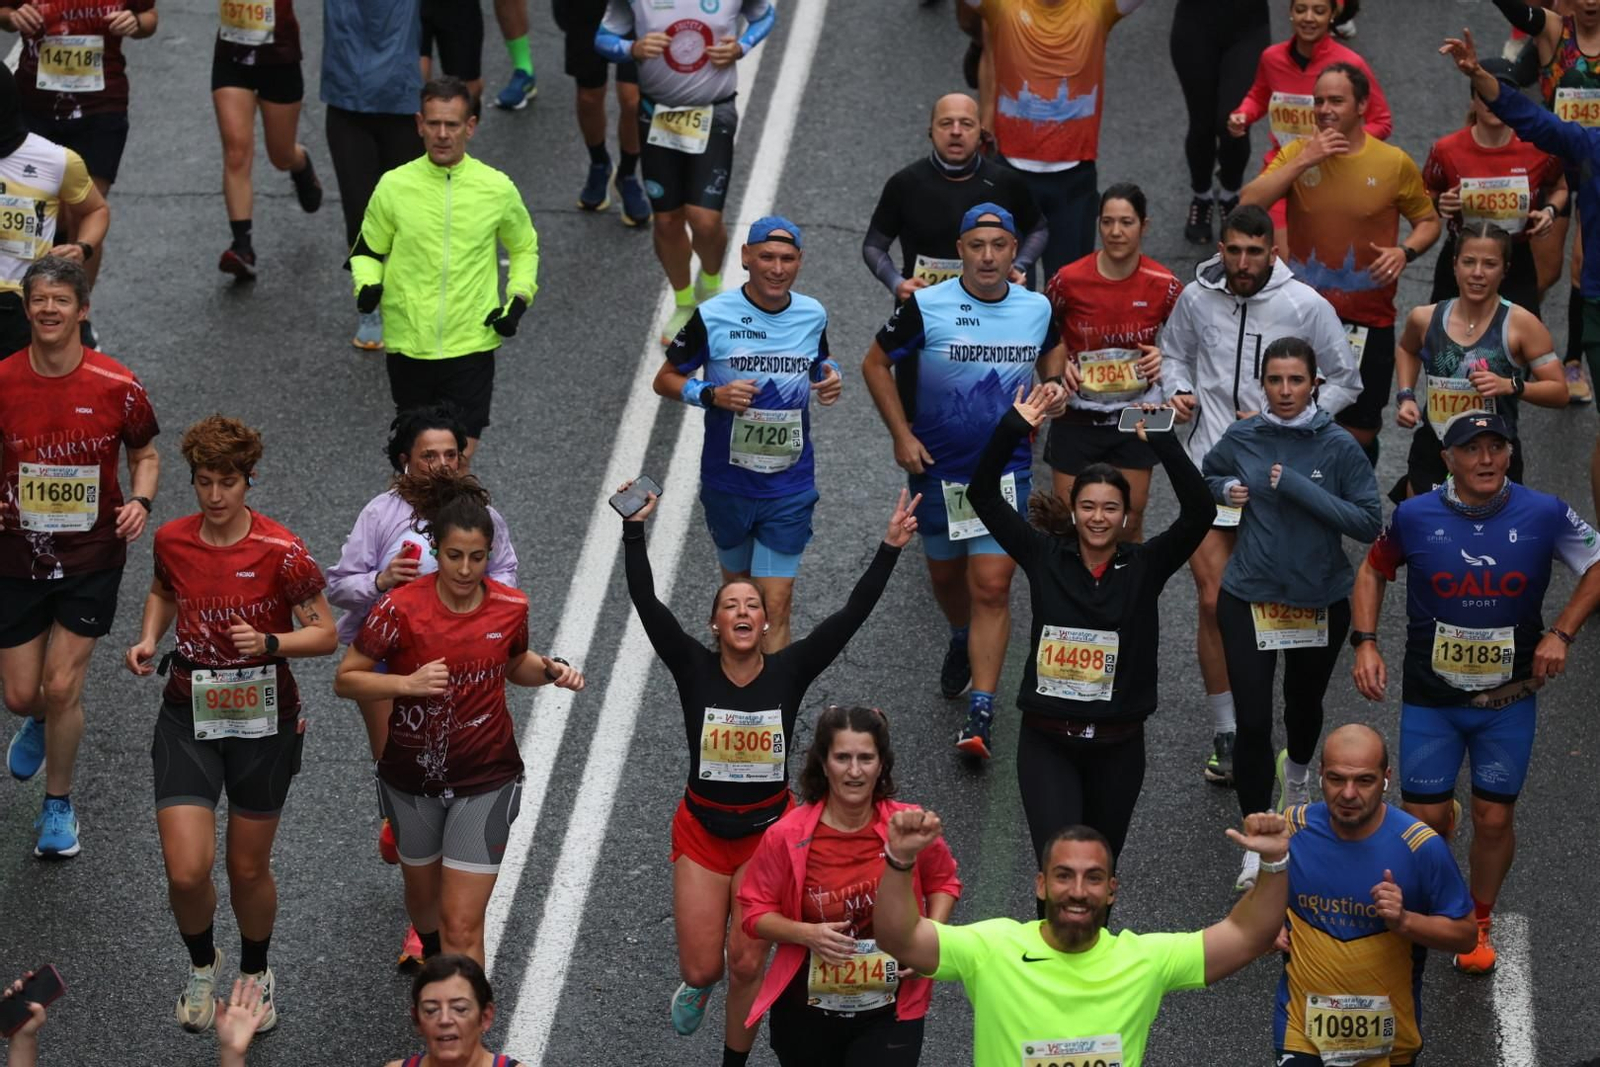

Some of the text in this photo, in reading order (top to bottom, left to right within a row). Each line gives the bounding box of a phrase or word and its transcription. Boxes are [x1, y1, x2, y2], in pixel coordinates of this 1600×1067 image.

[44, 48, 93, 67] 14718
[1466, 192, 1519, 211] 12633
[955, 316, 980, 327] JAVI
[729, 330, 767, 340] ANTONIO
[949, 344, 1037, 363] INDEPENDIENTES
[1086, 362, 1136, 385] 13641
[743, 424, 788, 446] 7120
[26, 481, 85, 502] 11680
[1431, 569, 1528, 599] GALO
[1462, 599, 1498, 608] SPORT
[1044, 644, 1104, 671] 14498
[1440, 641, 1501, 664] 13183
[205, 685, 259, 710] 9266
[709, 728, 771, 752] 11306
[830, 877, 878, 904] MEDI
[818, 958, 884, 985] 11214
[1313, 1013, 1380, 1039] 10981
